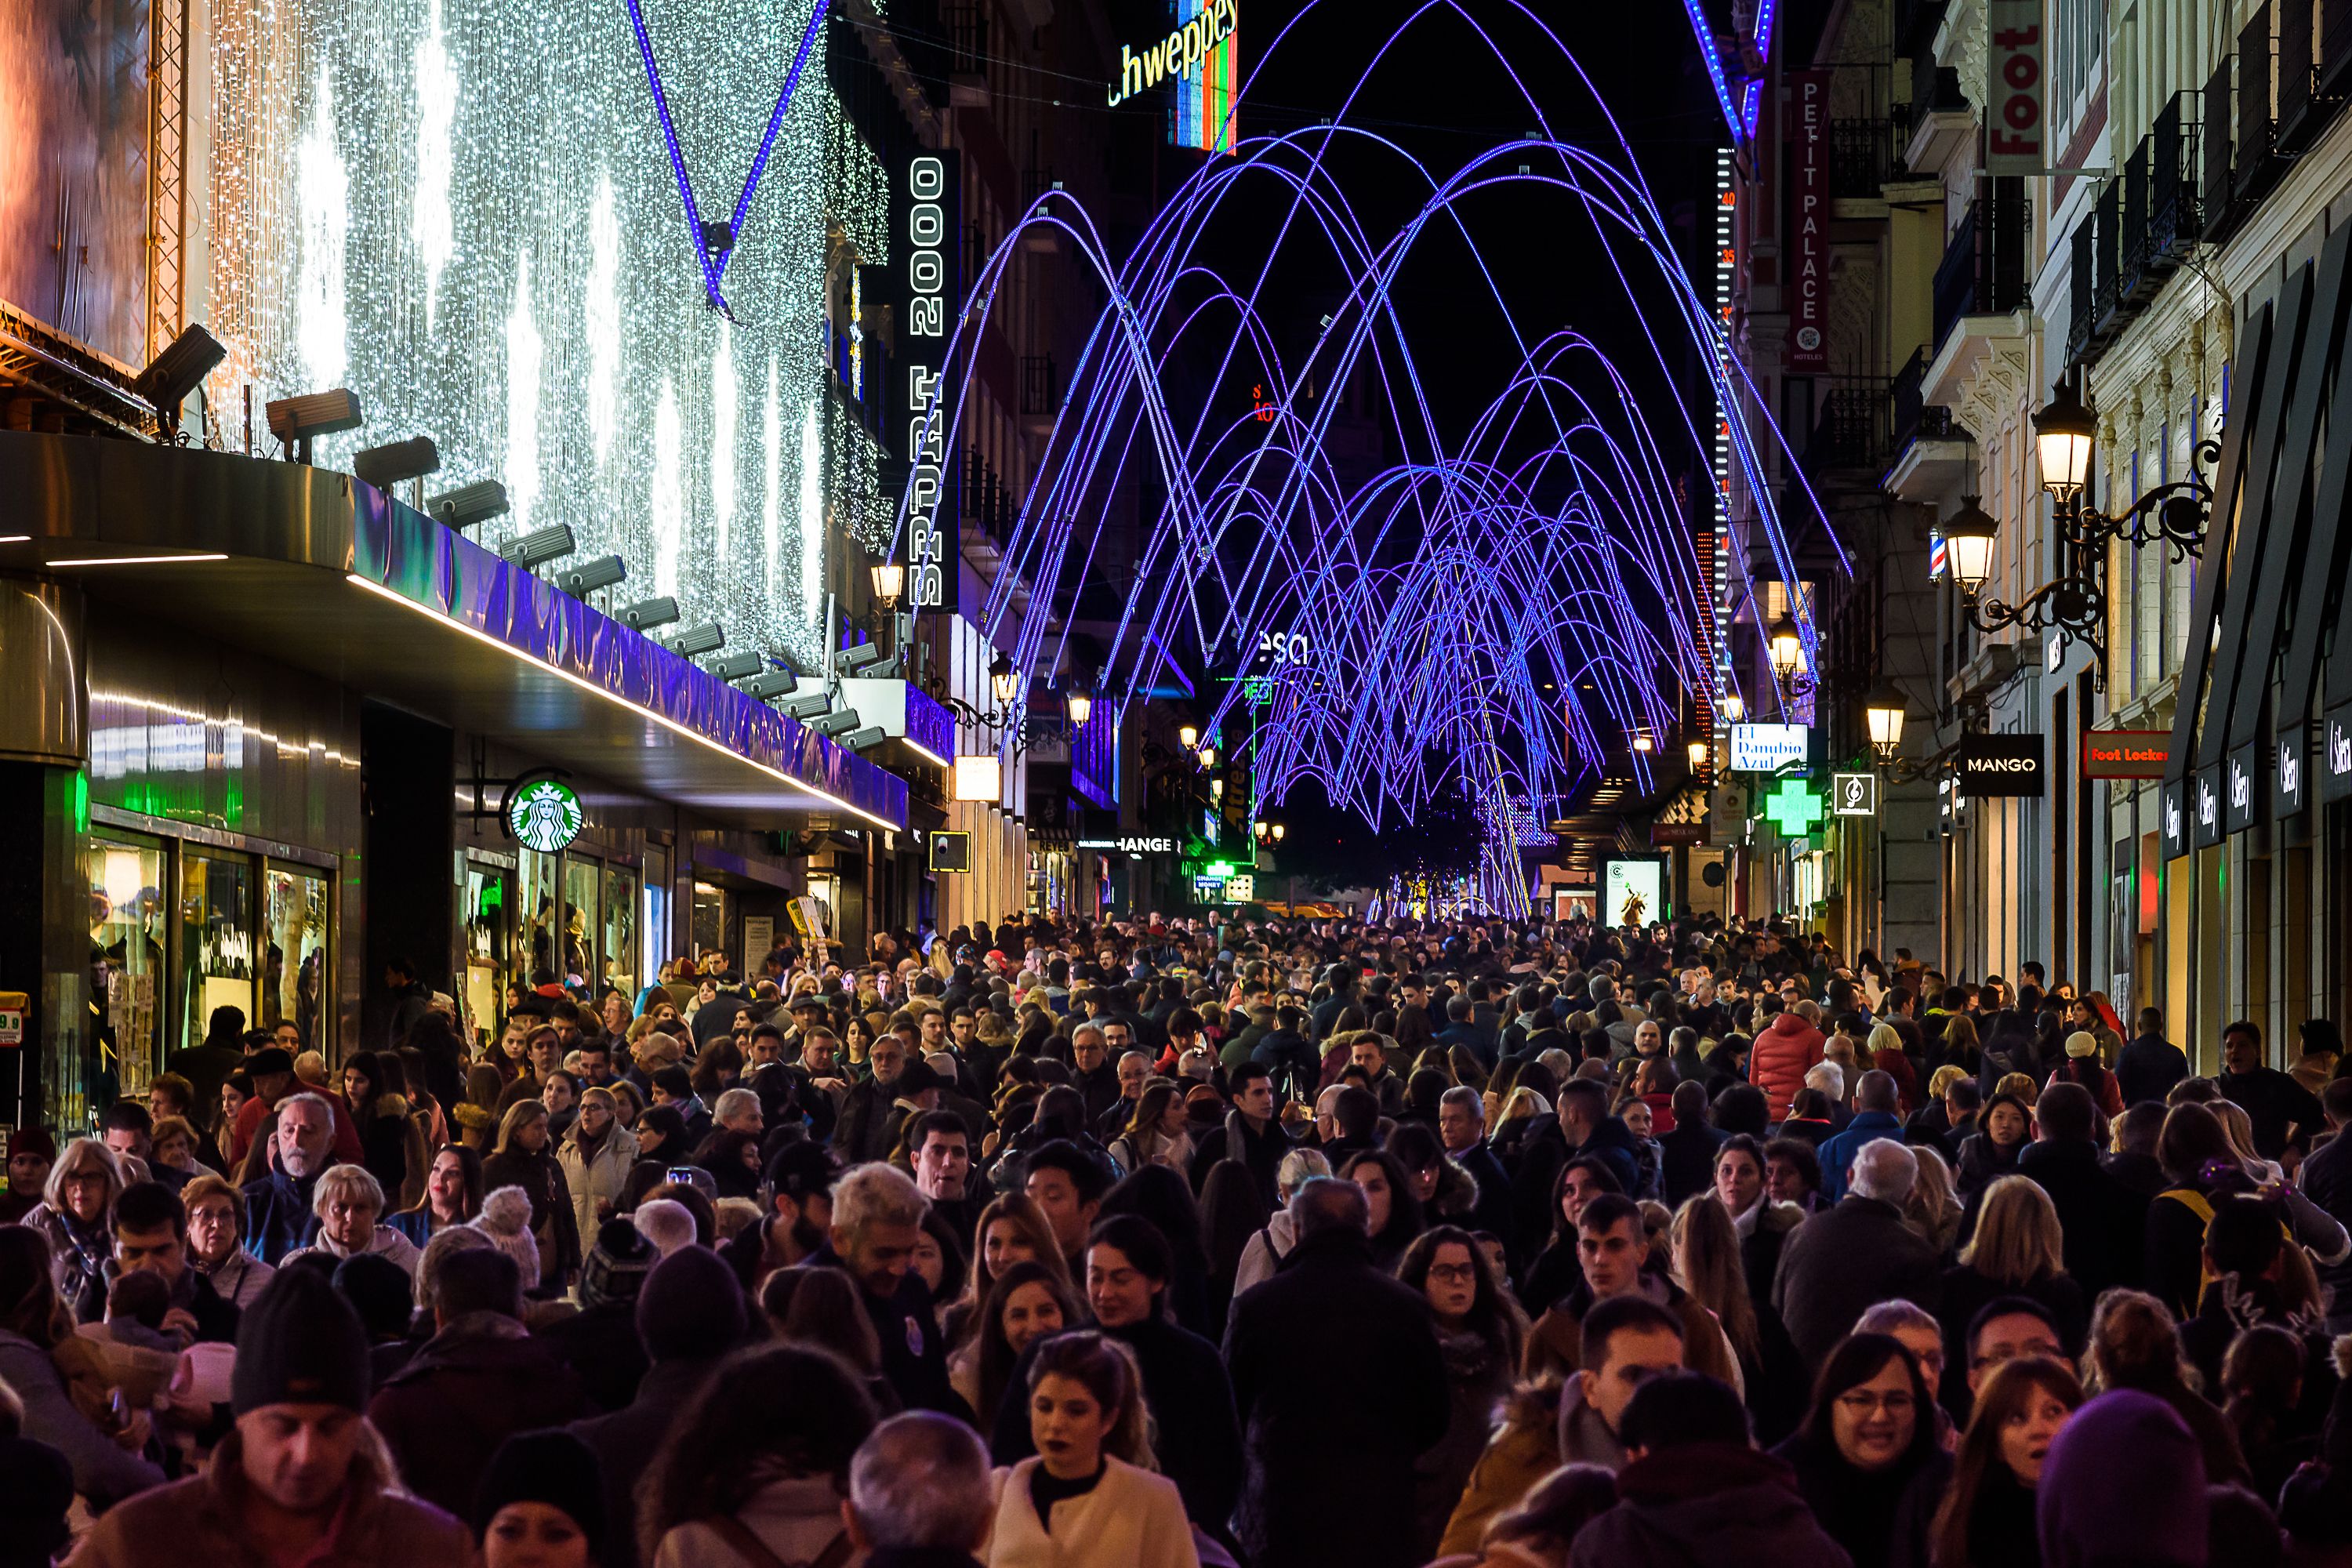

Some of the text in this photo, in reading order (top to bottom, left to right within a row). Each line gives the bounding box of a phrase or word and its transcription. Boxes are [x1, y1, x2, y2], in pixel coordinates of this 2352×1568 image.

[1990, 25, 2038, 154] Foot
[1722, 192, 1736, 206] 40
[1802, 83, 1817, 319] PETIT PALACE
[1722, 249, 1736, 263] 35
[909, 157, 942, 607] SPORT 2000
[1738, 724, 1755, 739] El
[1738, 739, 1802, 756] Danubio
[2091, 747, 2121, 761] Foot
[1737, 755, 1774, 769] Azul
[1968, 758, 2036, 771] MANGO
[1040, 841, 1069, 852] REYES
